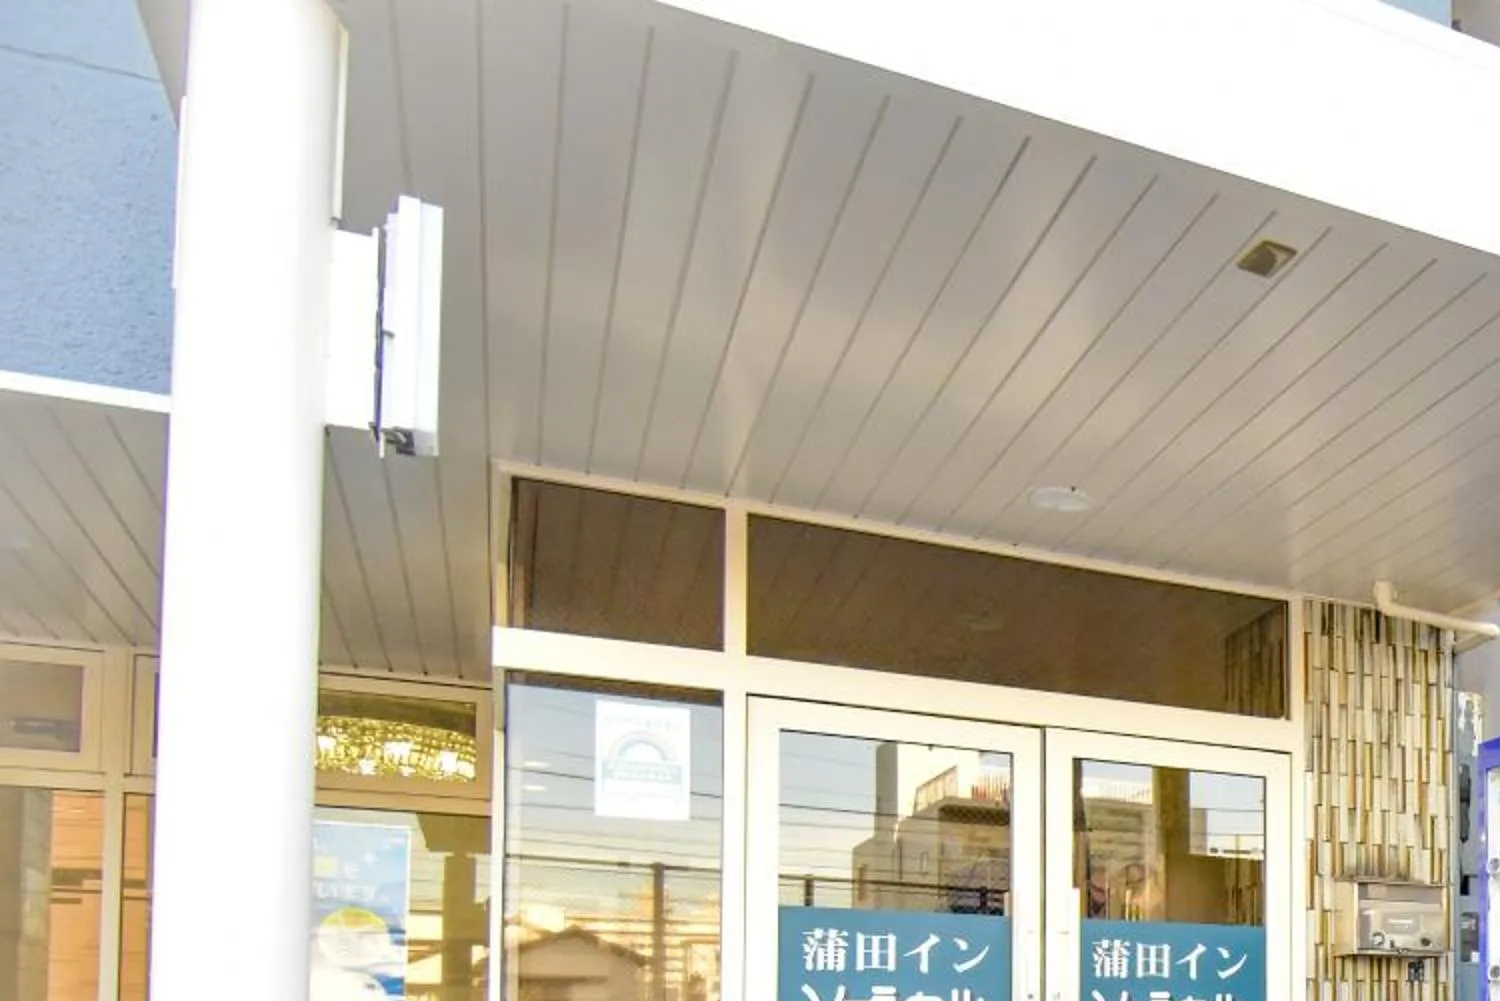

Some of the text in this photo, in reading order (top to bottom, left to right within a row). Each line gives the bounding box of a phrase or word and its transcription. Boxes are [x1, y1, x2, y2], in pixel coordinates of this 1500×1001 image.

[801, 927, 990, 973] 蒲田イン
[1092, 939, 1248, 979] 蒲田イン
